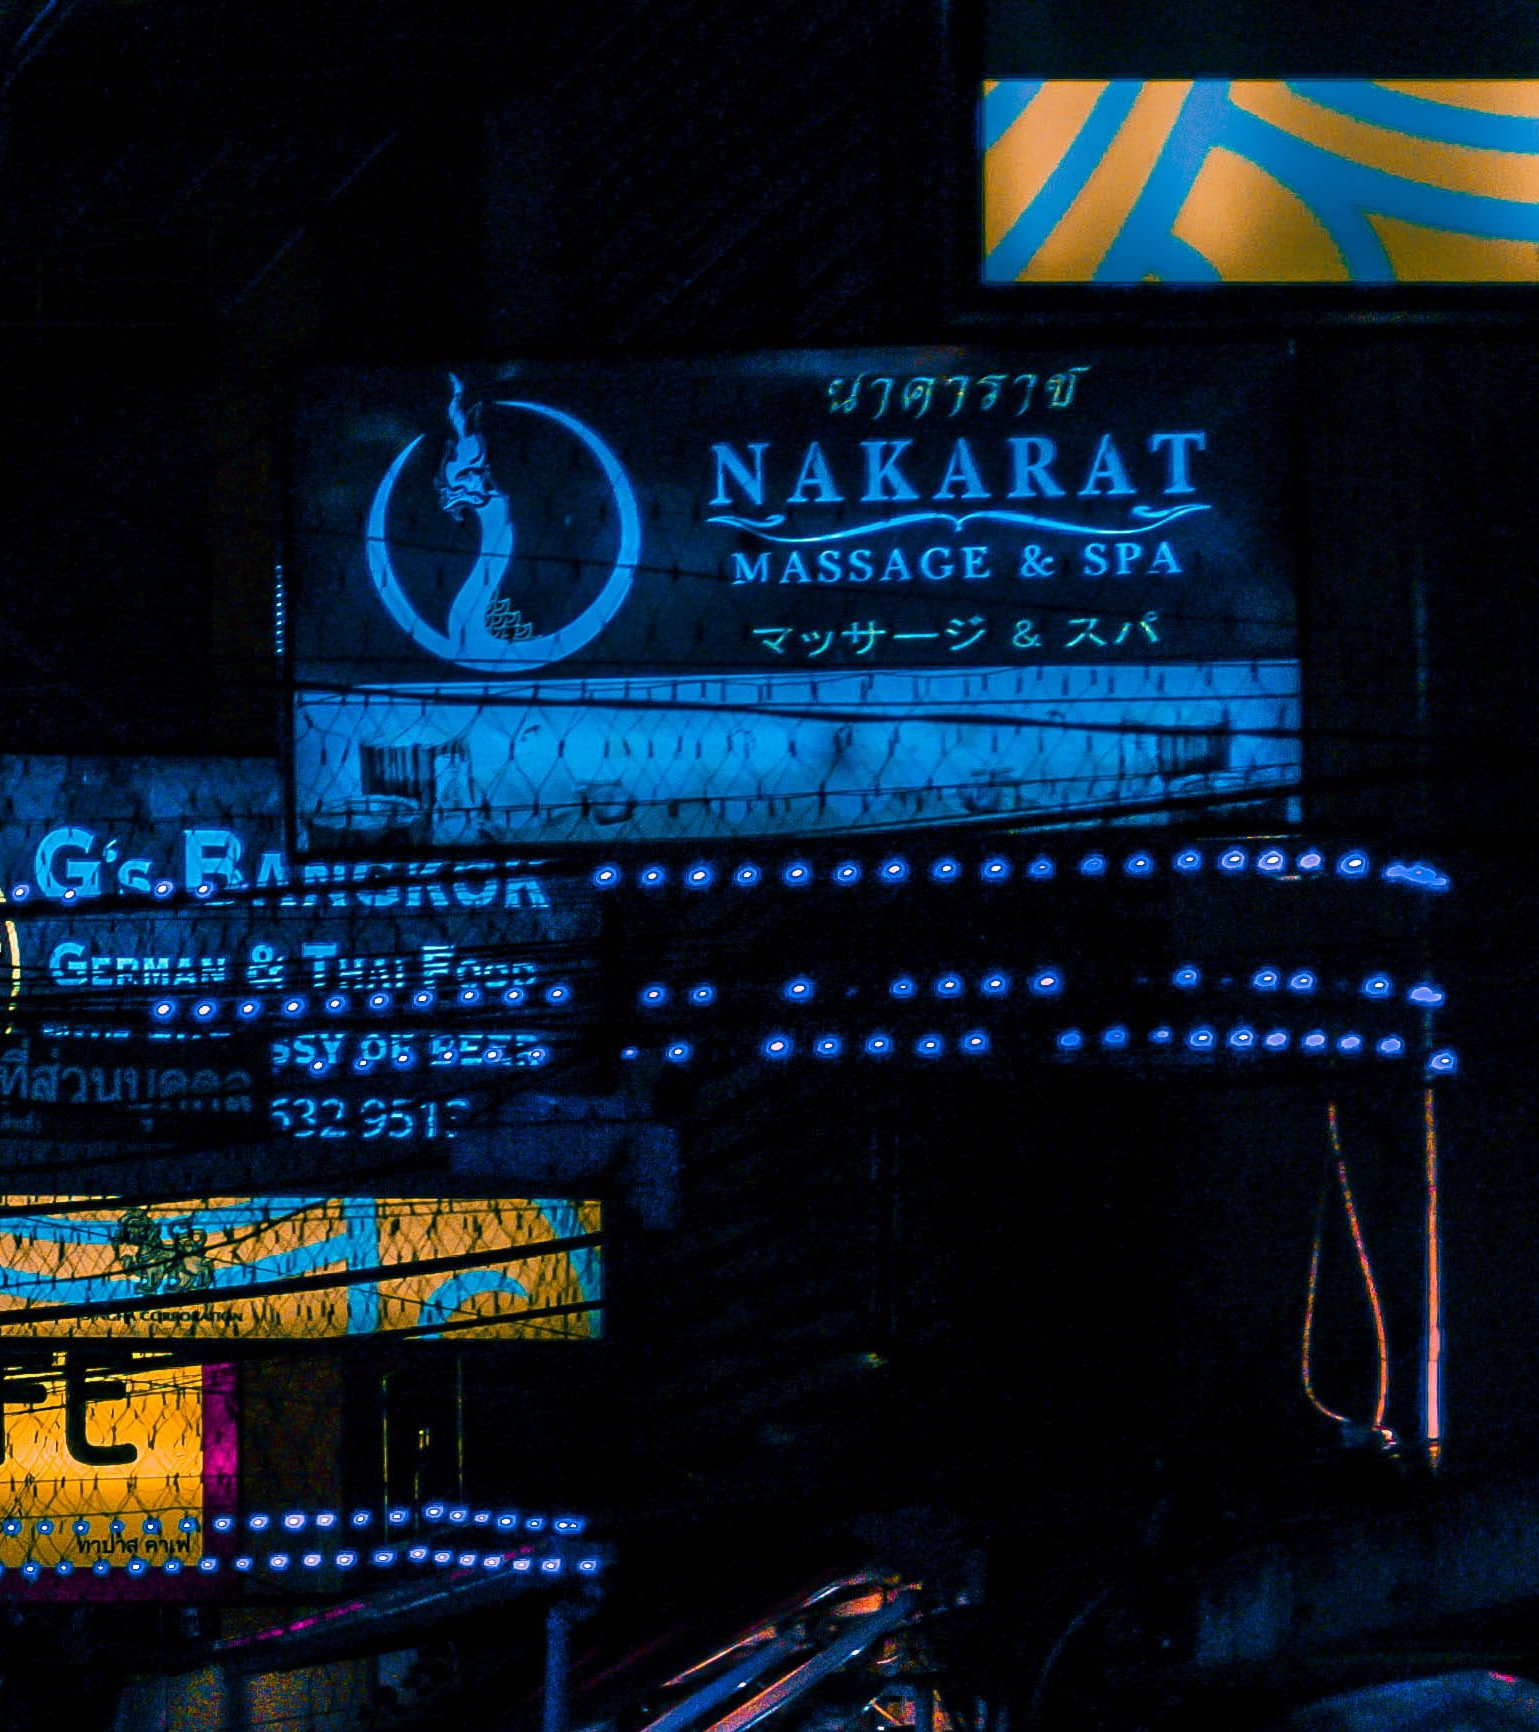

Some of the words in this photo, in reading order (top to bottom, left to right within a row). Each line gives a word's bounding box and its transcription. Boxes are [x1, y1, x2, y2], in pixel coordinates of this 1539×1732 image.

[708, 430, 1209, 509] NAKARAT
[730, 545, 991, 587] MASSAGE
[1018, 544, 1056, 580] &
[1082, 539, 1183, 579] SPA
[750, 613, 989, 657] マッサージ
[1011, 617, 1044, 651] &
[1065, 610, 1159, 649] スパ
